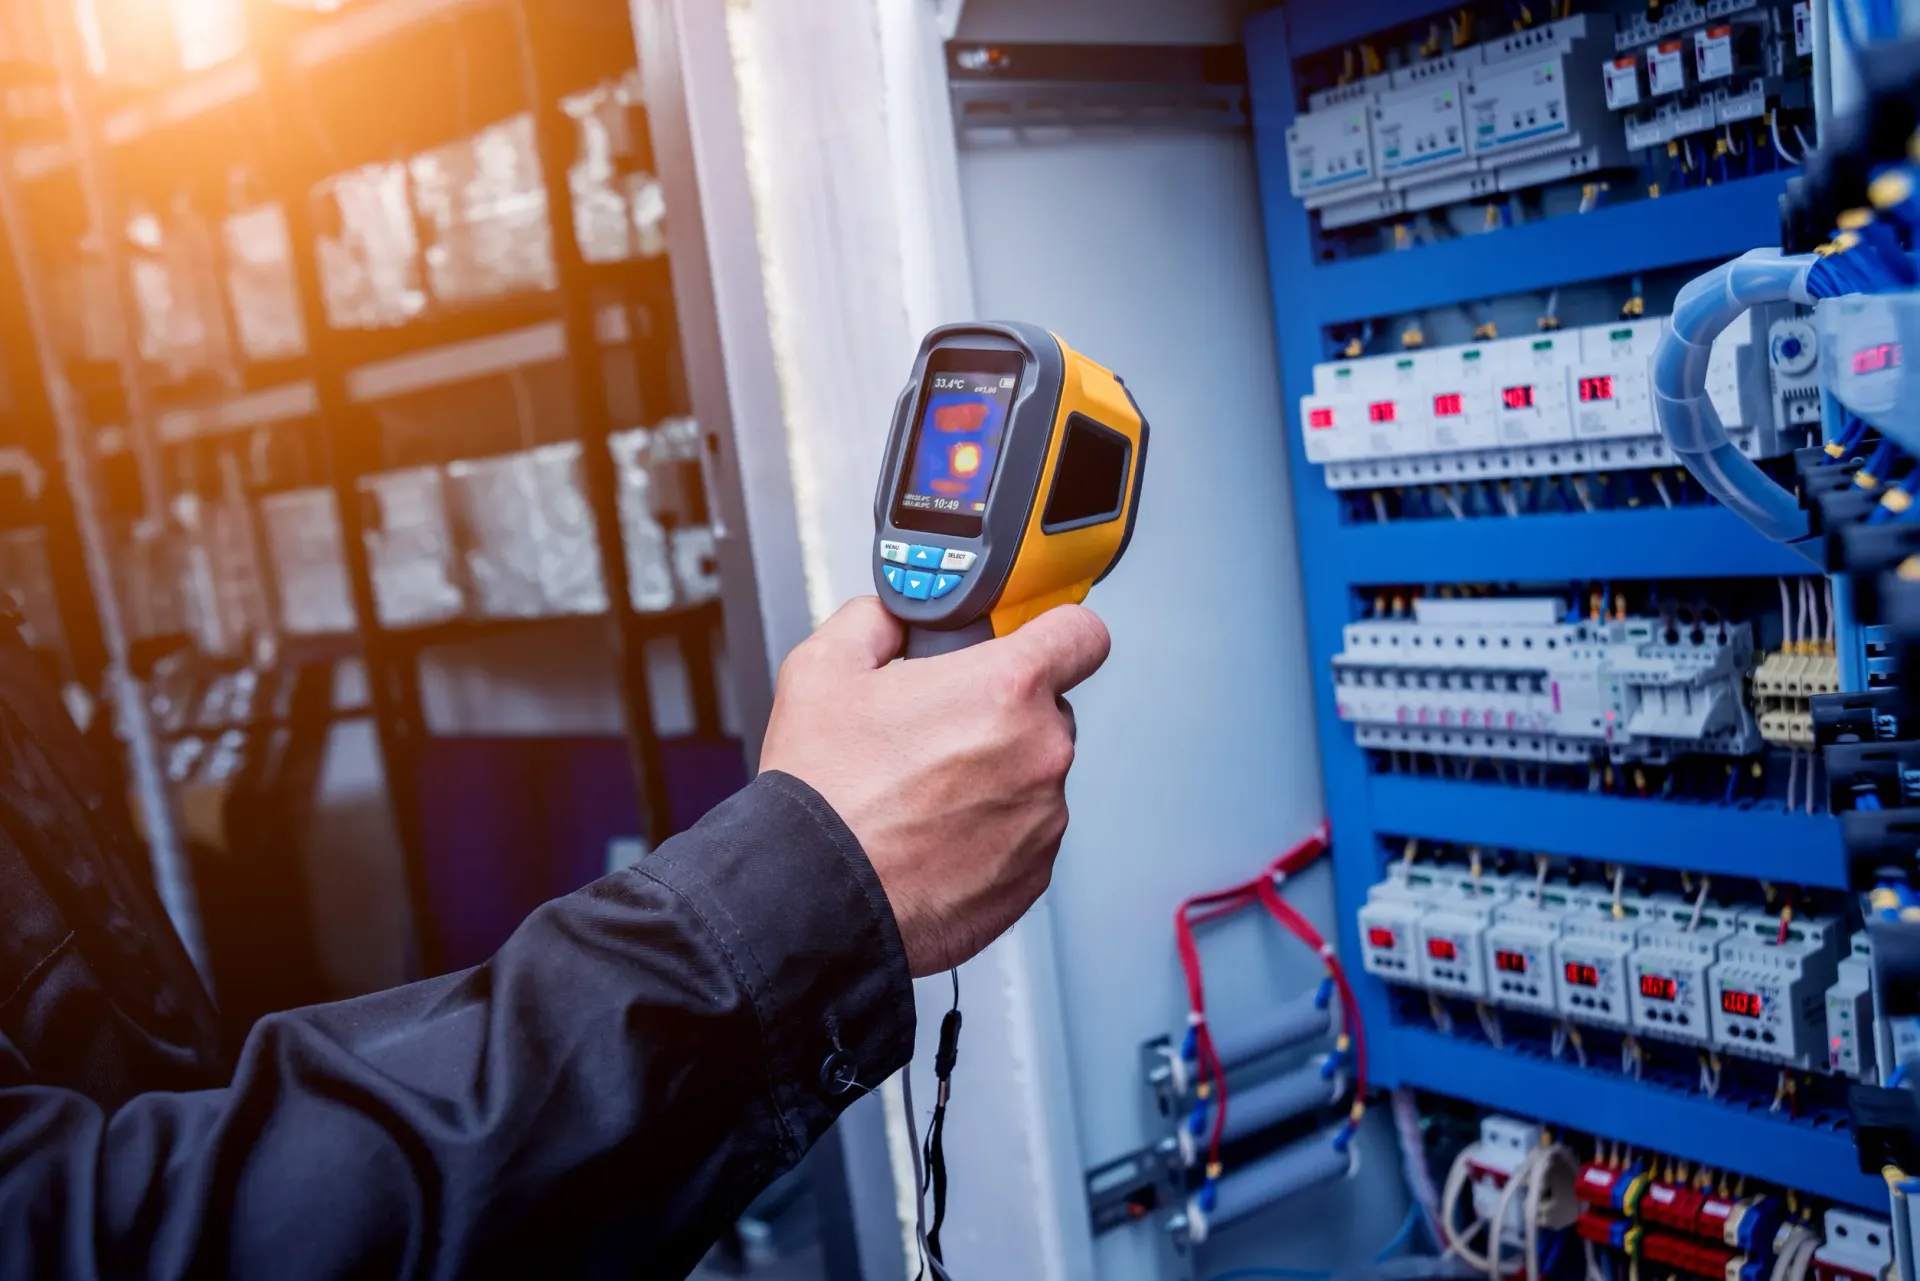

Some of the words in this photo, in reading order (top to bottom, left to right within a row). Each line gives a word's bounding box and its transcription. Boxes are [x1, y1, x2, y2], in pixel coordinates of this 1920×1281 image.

[934, 378, 965, 389] 33.4°C
[933, 498, 960, 511] 10:49
[884, 543, 900, 551] MENU
[947, 552, 966, 560] SELECT
